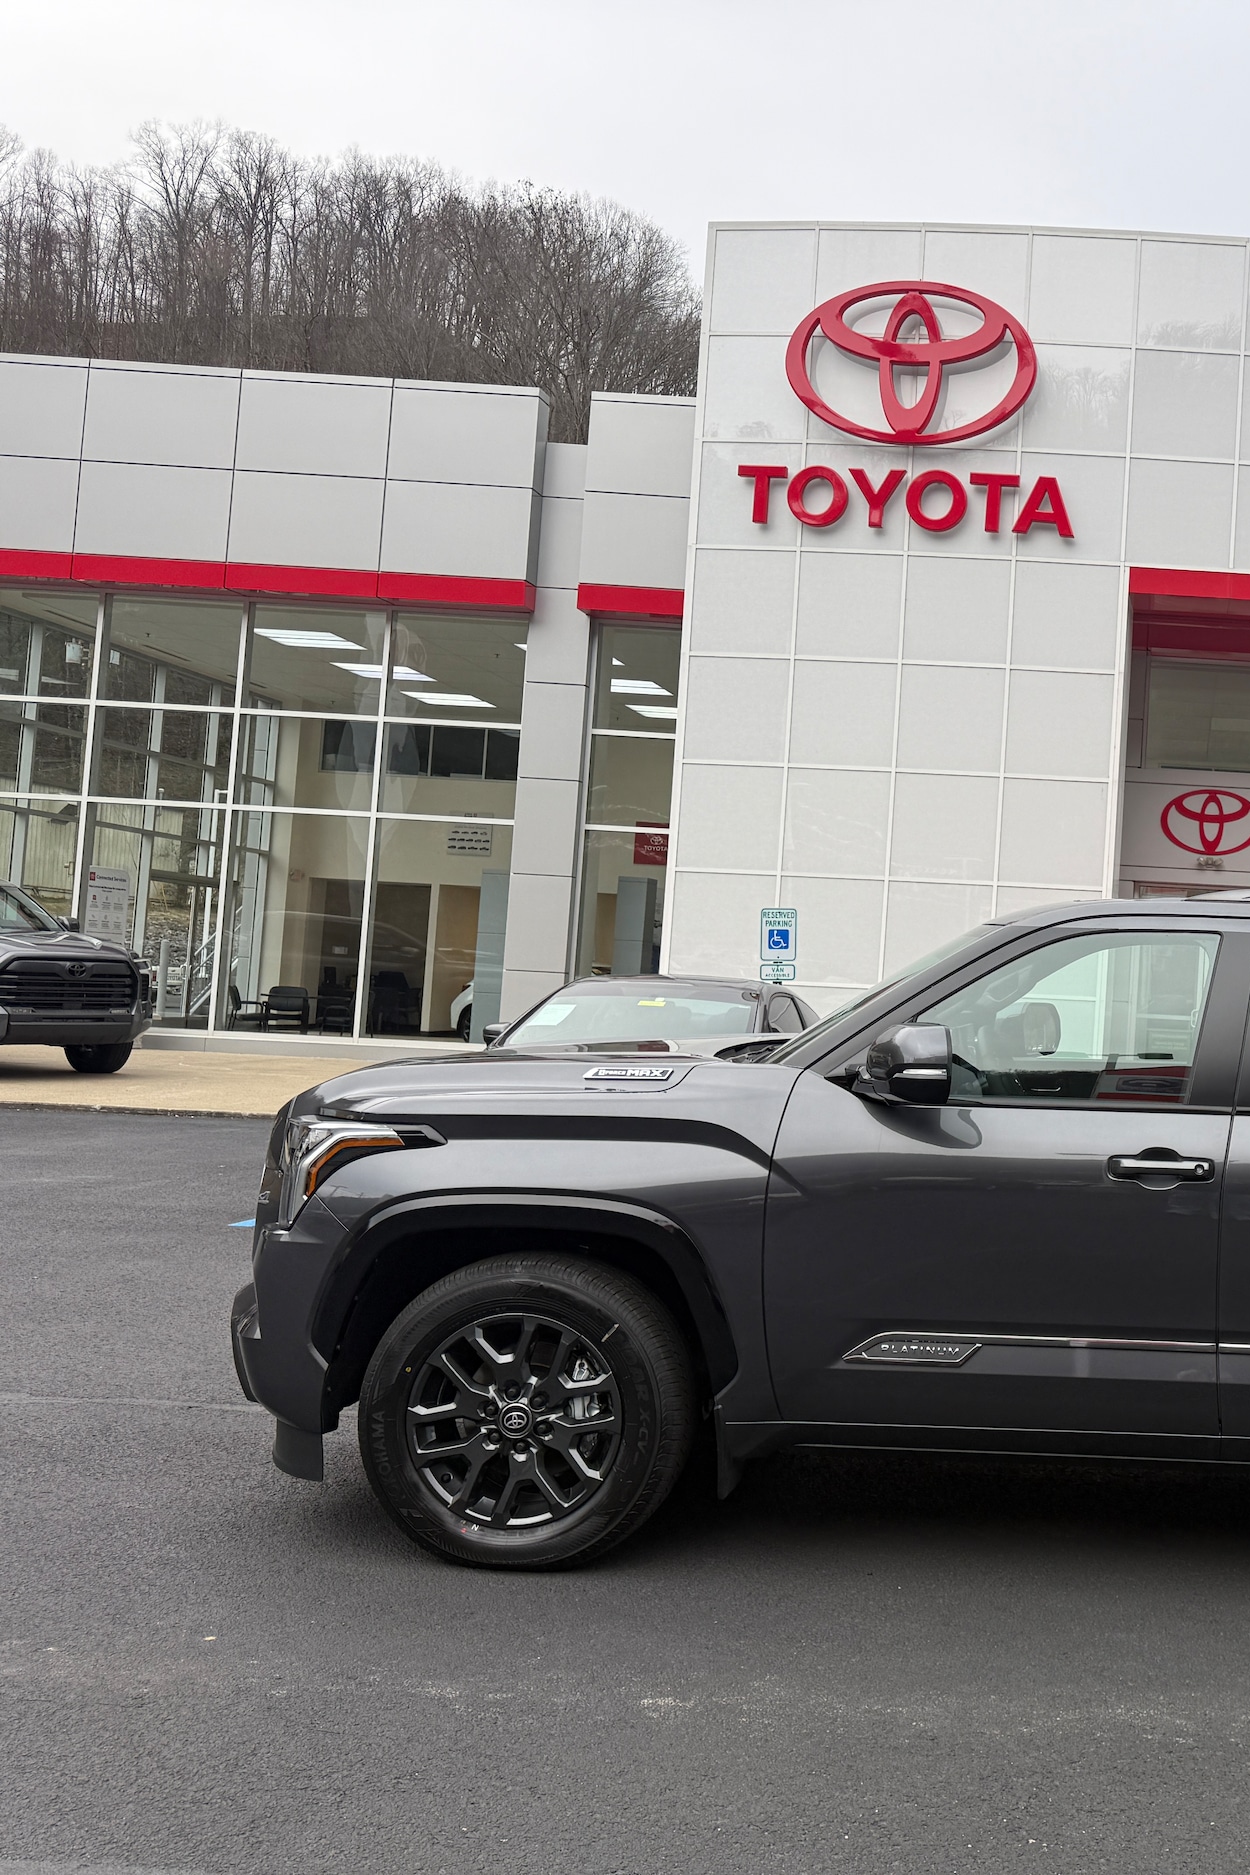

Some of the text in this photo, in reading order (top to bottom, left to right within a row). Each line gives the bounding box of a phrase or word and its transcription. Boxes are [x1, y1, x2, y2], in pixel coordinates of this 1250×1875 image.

[737, 464, 1075, 539] TOYOTA
[762, 911, 795, 919] RESERVED
[765, 920, 793, 928] PARKING
[880, 1344, 960, 1355] PLATINUM
